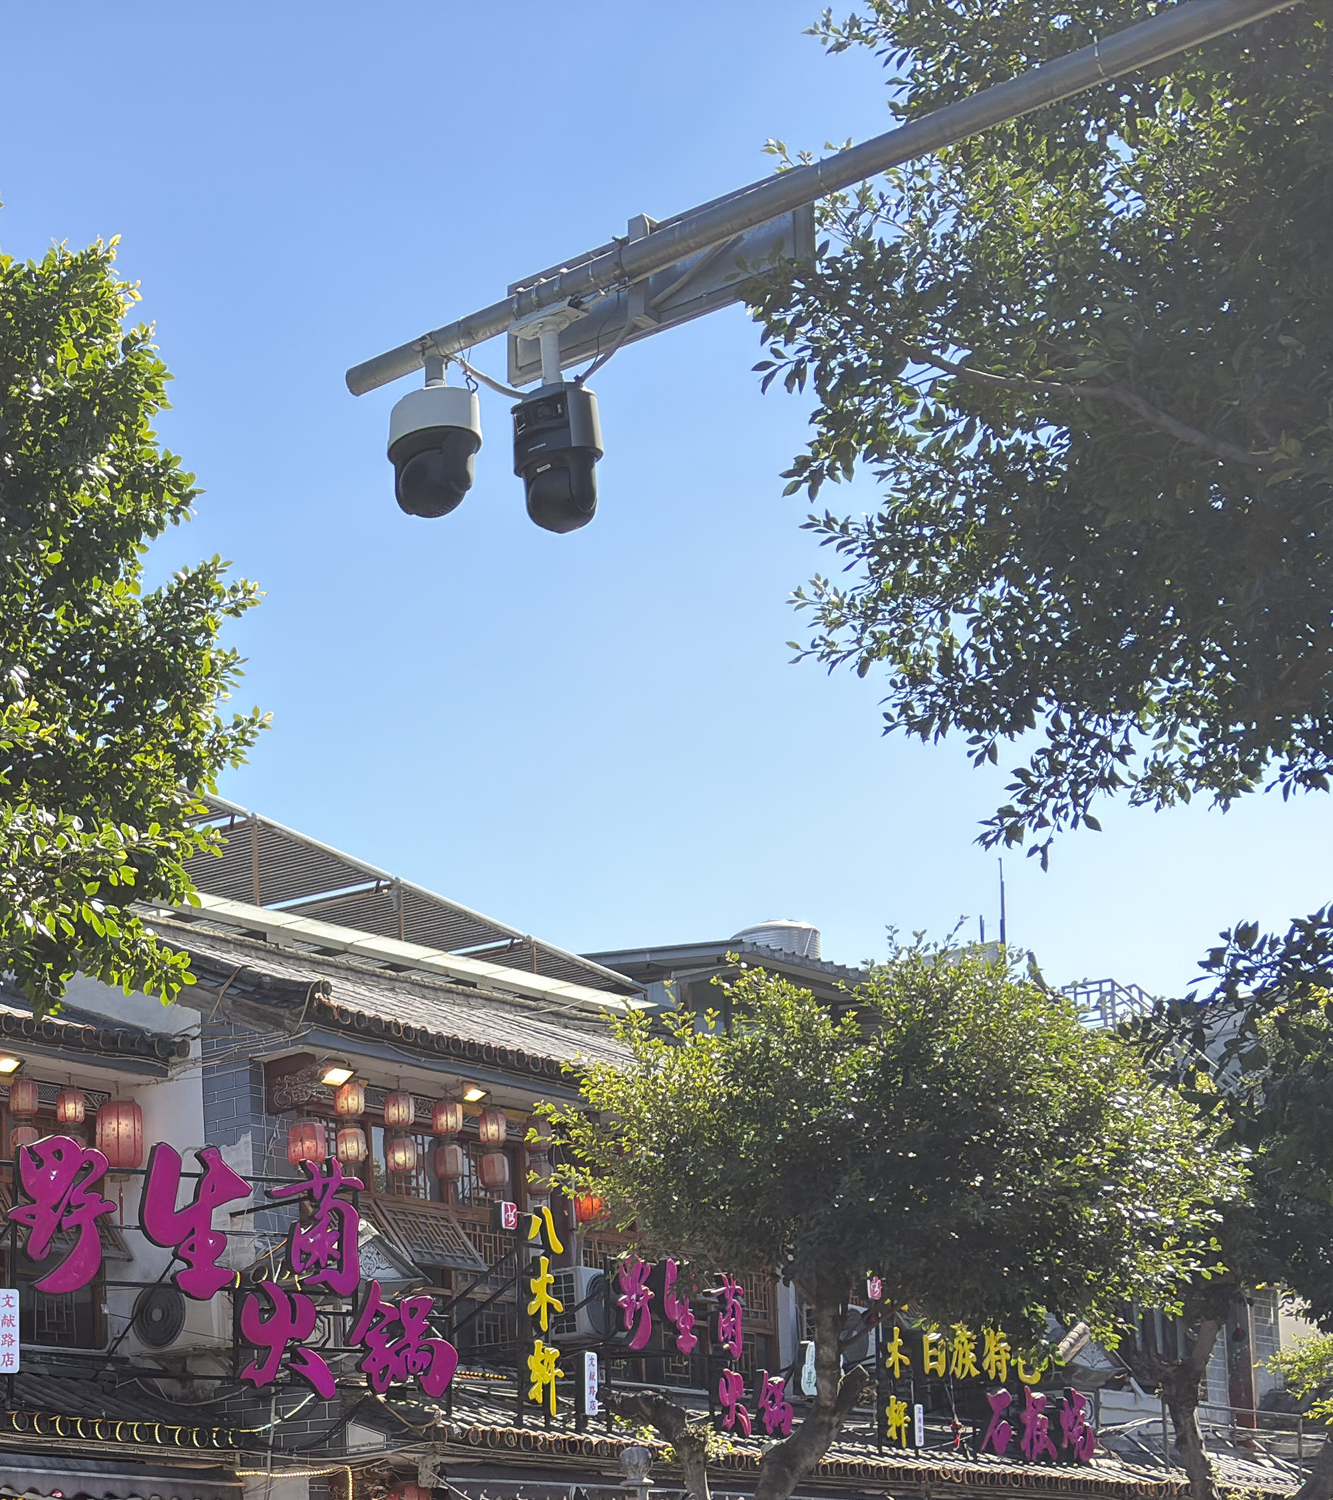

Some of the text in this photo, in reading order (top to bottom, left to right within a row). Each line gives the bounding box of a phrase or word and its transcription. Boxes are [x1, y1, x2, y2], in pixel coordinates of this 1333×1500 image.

[7, 1134, 365, 1299] 野生菌
[0, 1294, 16, 1368] 文献路店
[239, 1279, 458, 1399] 火锅
[527, 1206, 564, 1417] 八木轩
